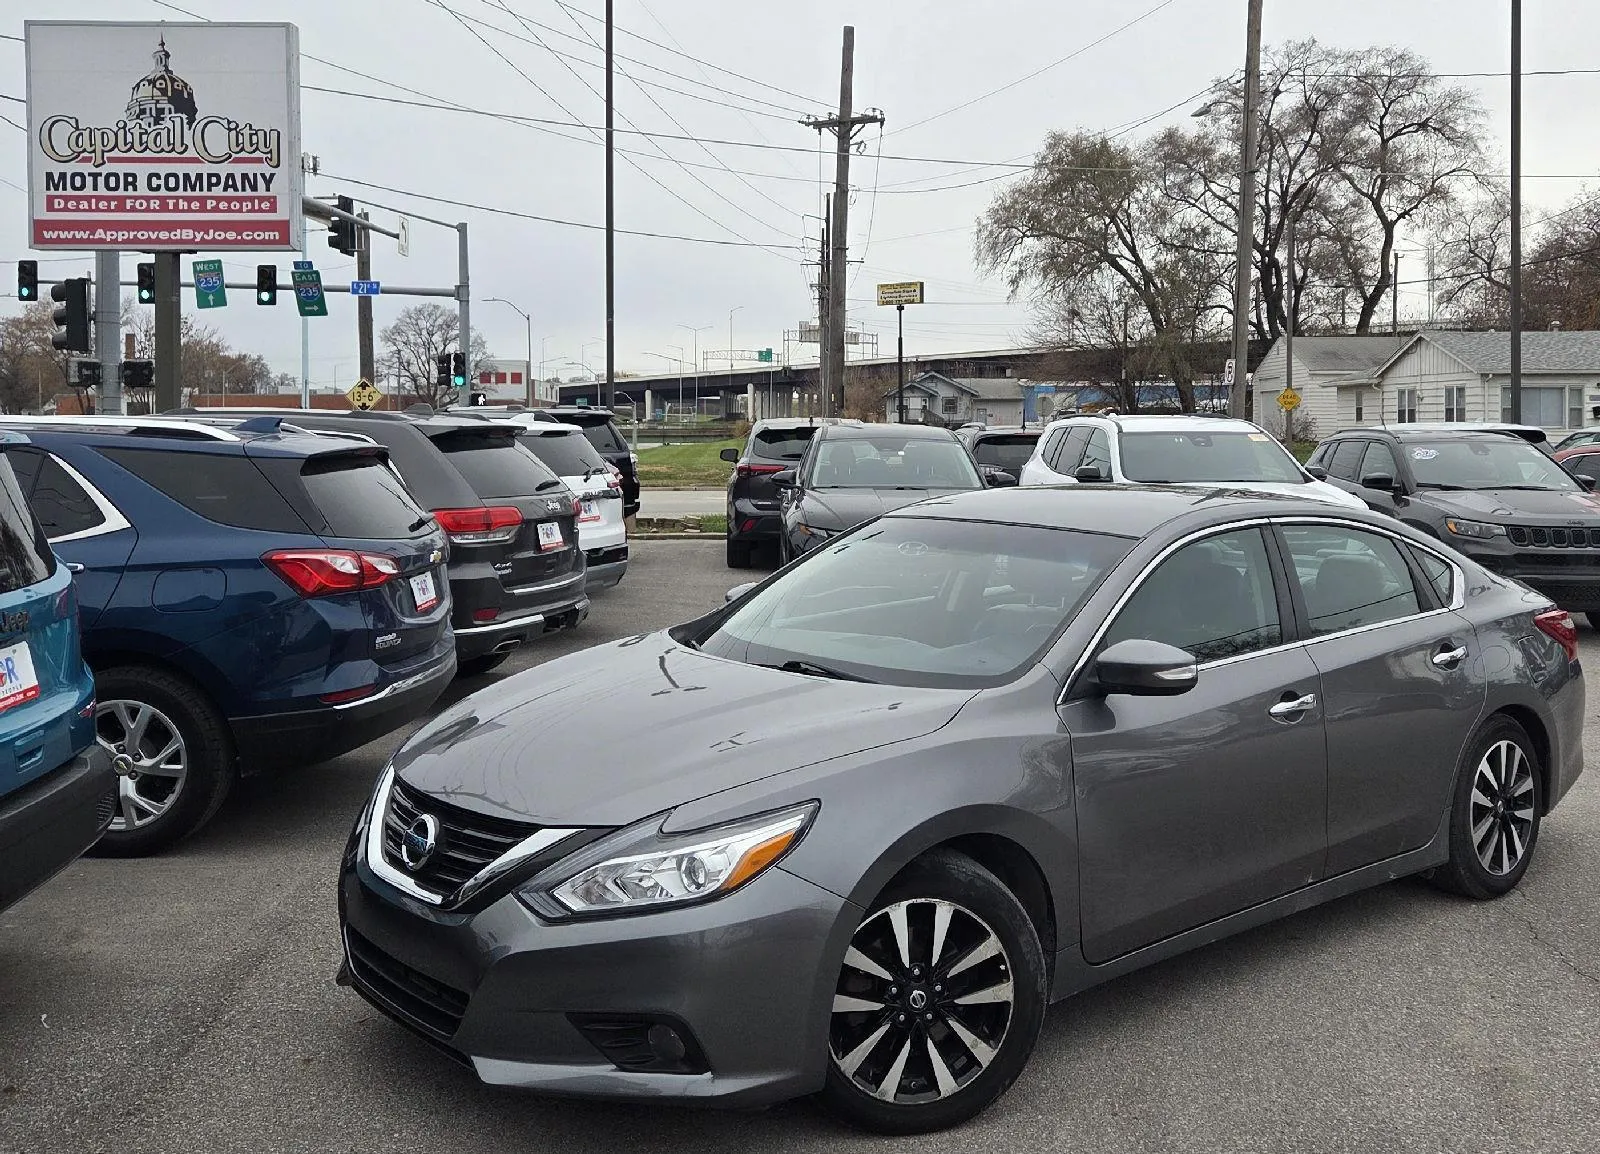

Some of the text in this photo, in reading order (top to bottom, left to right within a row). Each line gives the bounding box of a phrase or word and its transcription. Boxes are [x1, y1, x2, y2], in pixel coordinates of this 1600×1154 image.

[39, 114, 281, 168] Capital City
[46, 171, 276, 192] MOTOR COMPANY
[54, 198, 271, 213] Dealer FOR The People
[43, 228, 280, 242] www.ApprovedByJoe.com
[196, 262, 220, 271] WEST
[200, 277, 220, 288] 235
[295, 273, 318, 281] EAST
[300, 287, 319, 297] 235
